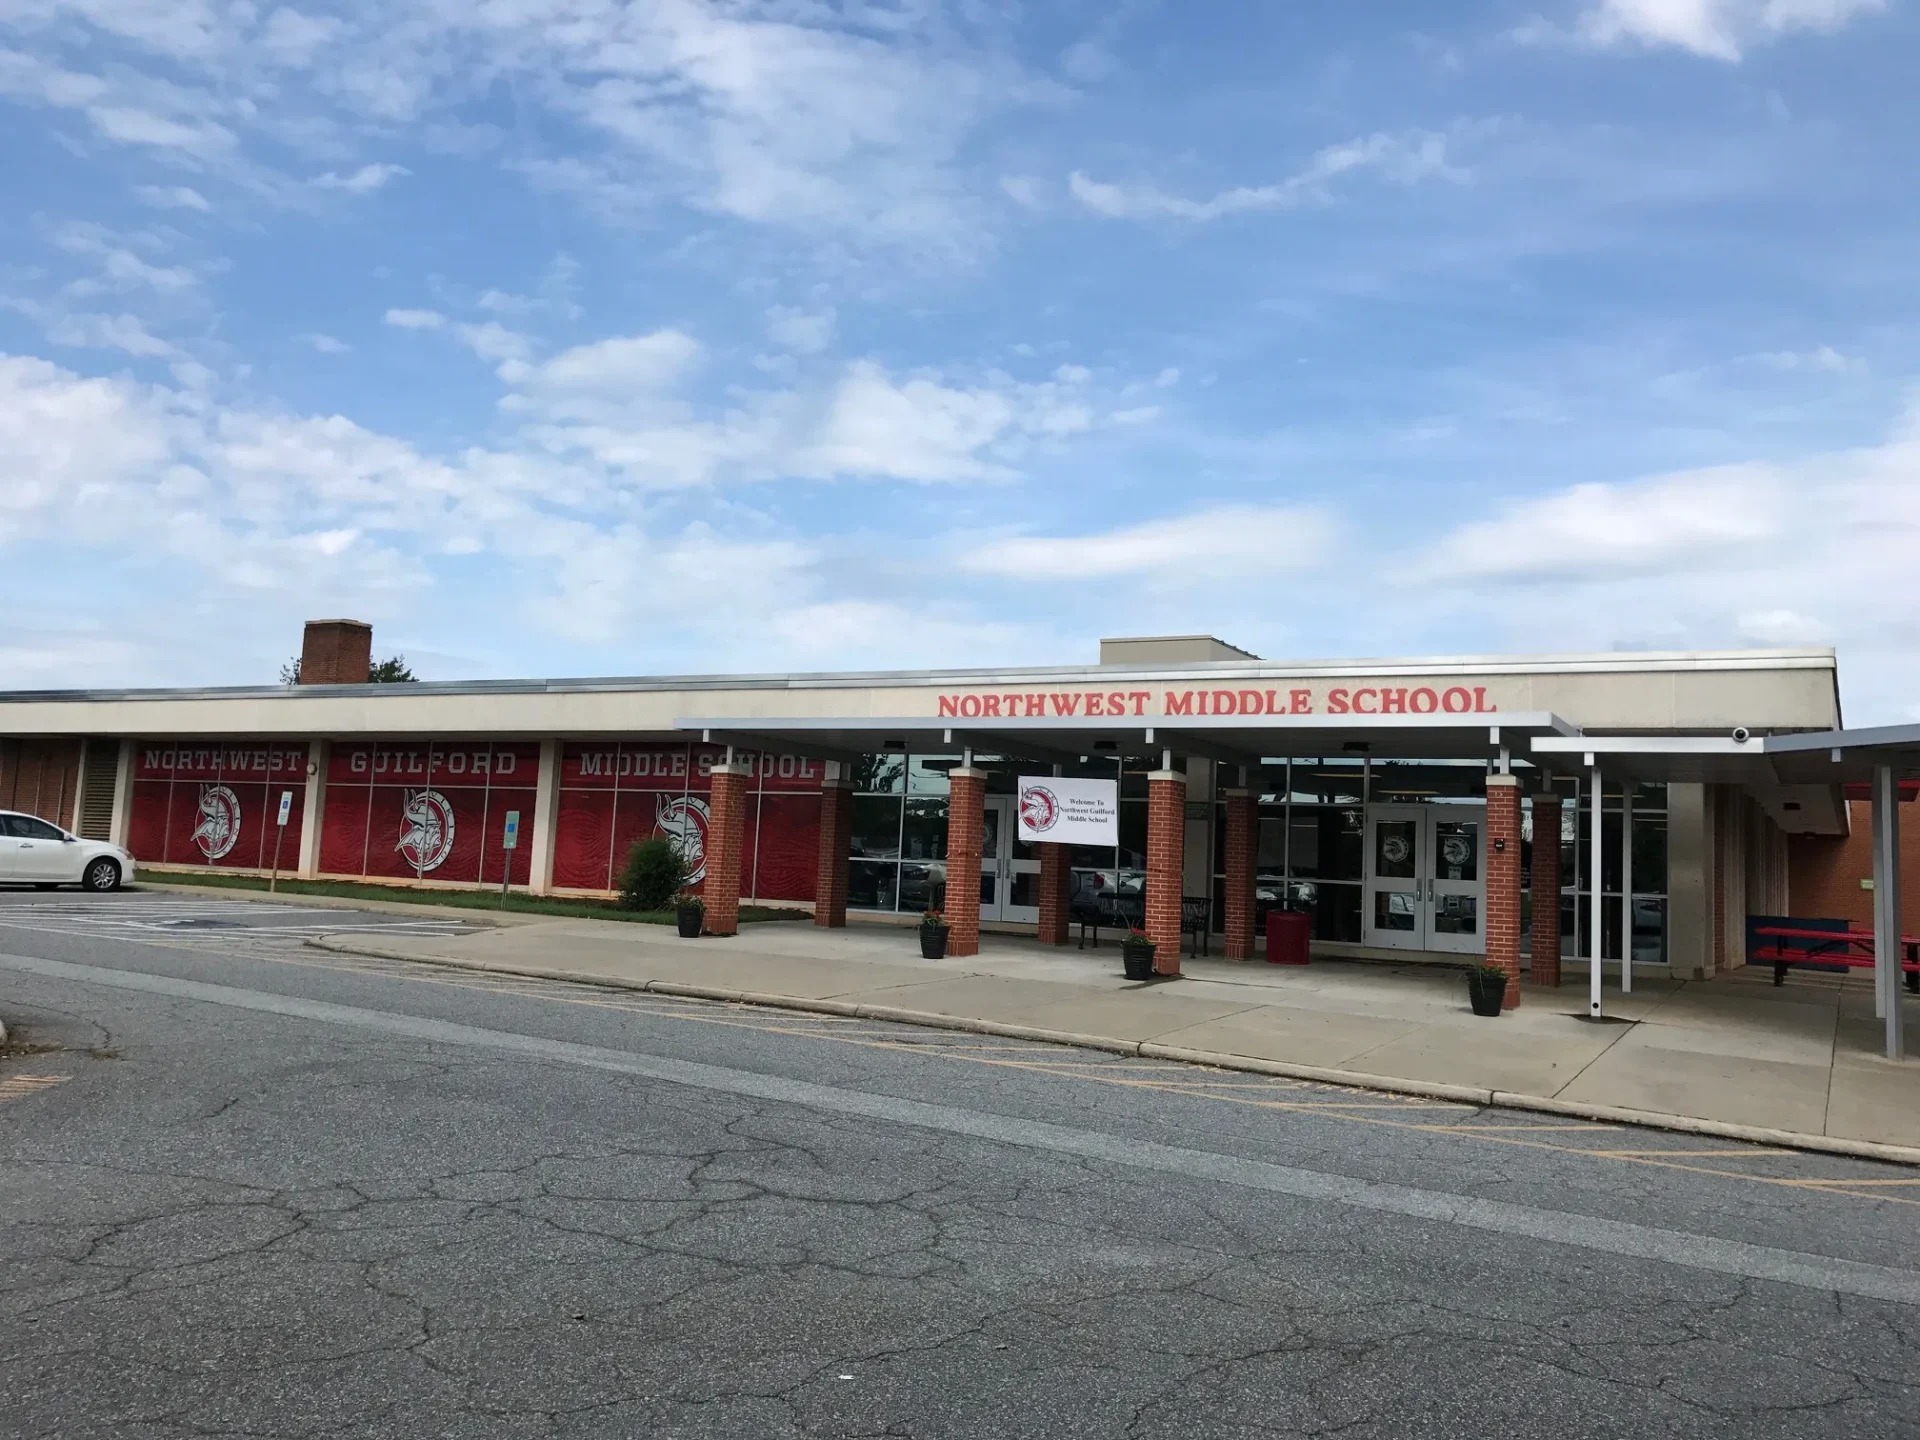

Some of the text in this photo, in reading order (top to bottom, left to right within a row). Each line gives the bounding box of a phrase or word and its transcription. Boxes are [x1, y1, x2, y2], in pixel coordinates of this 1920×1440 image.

[937, 687, 1497, 717] NORTHWEST MIDDLE SCHOOL
[144, 750, 302, 772] NORTHWEST
[350, 752, 516, 775] GUILFORD
[581, 753, 686, 777] MIDDLE
[1069, 798, 1095, 806] Welcome
